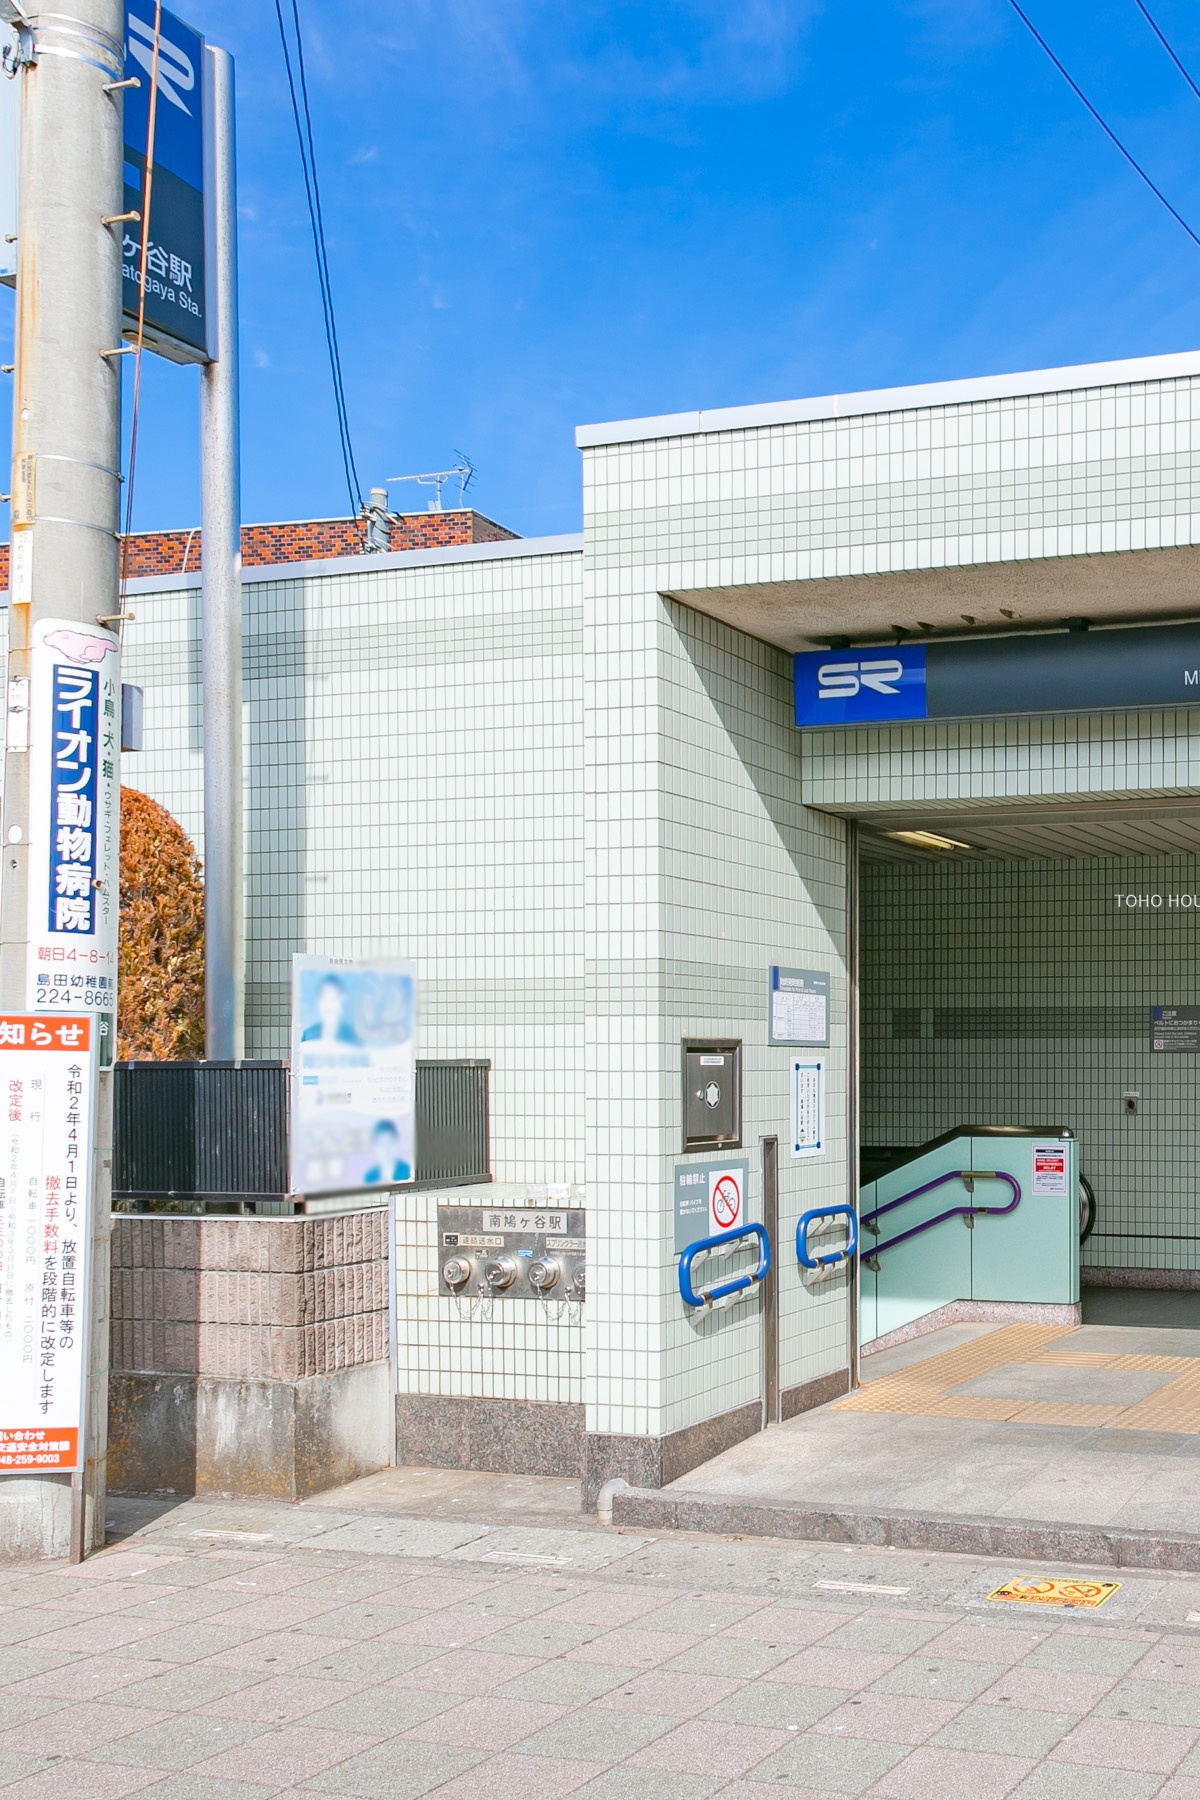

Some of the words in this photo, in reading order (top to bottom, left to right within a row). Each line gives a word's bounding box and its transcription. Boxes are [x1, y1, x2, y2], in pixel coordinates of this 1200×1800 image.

[123, 12, 196, 118] R
[179, 291, 202, 317] Sta.
[817, 659, 903, 699] SR
[55, 666, 93, 931] ライオン動物病院
[8, 1078, 24, 1122] 改定後
[488, 1214, 562, 1230] 南鳩ヶ谷駅
[0, 1453, 60, 1465] 48-259-9003
